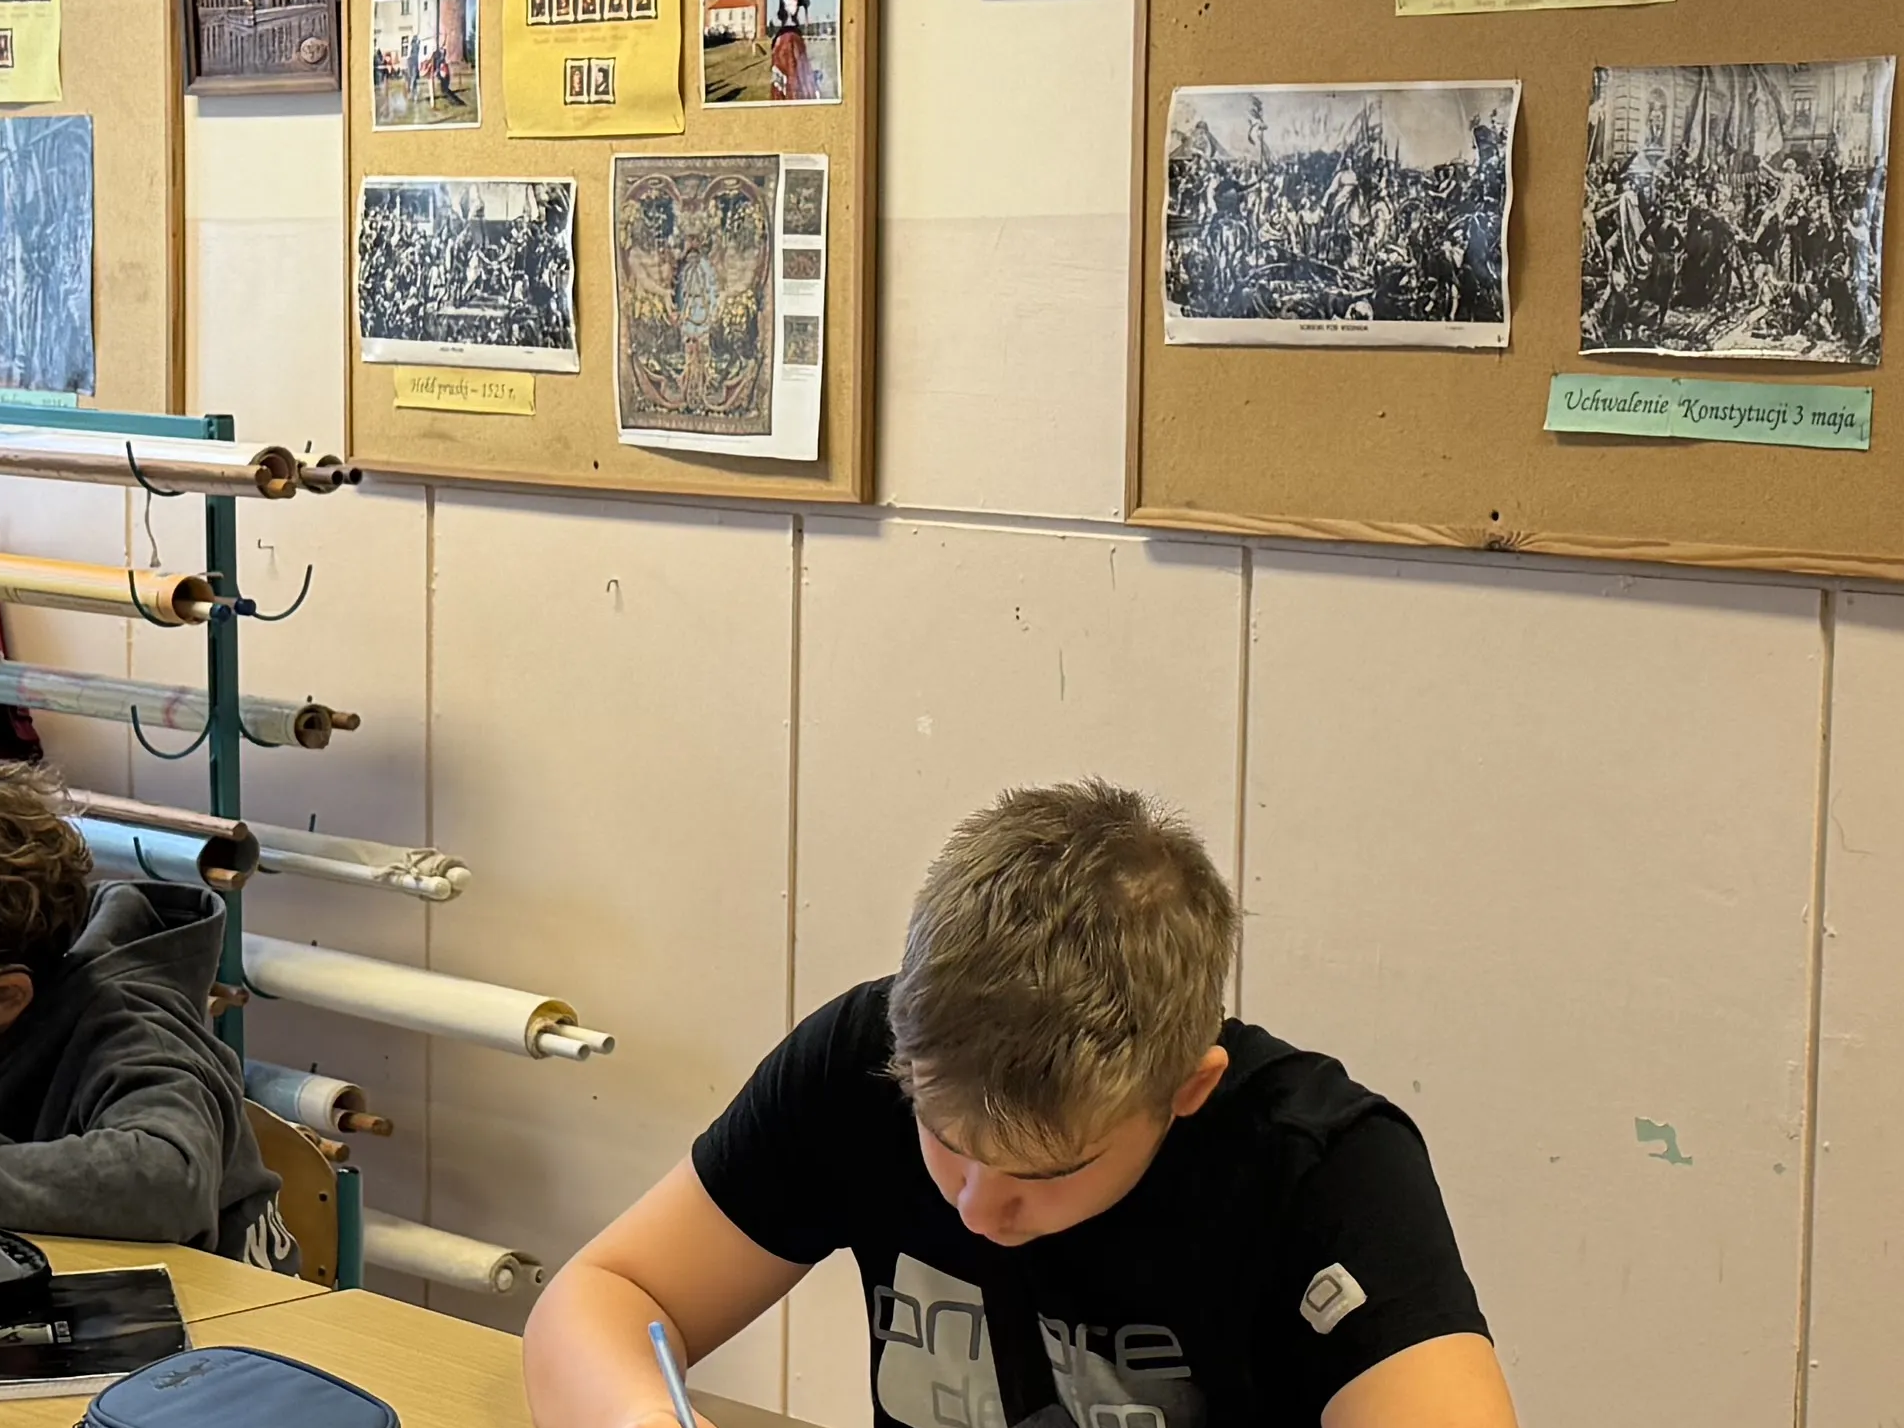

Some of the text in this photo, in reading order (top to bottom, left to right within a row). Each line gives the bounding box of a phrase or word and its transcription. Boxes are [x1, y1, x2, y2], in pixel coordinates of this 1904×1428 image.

[1564, 388, 1856, 435] Uchwalenie Konstytucji 3 maja
